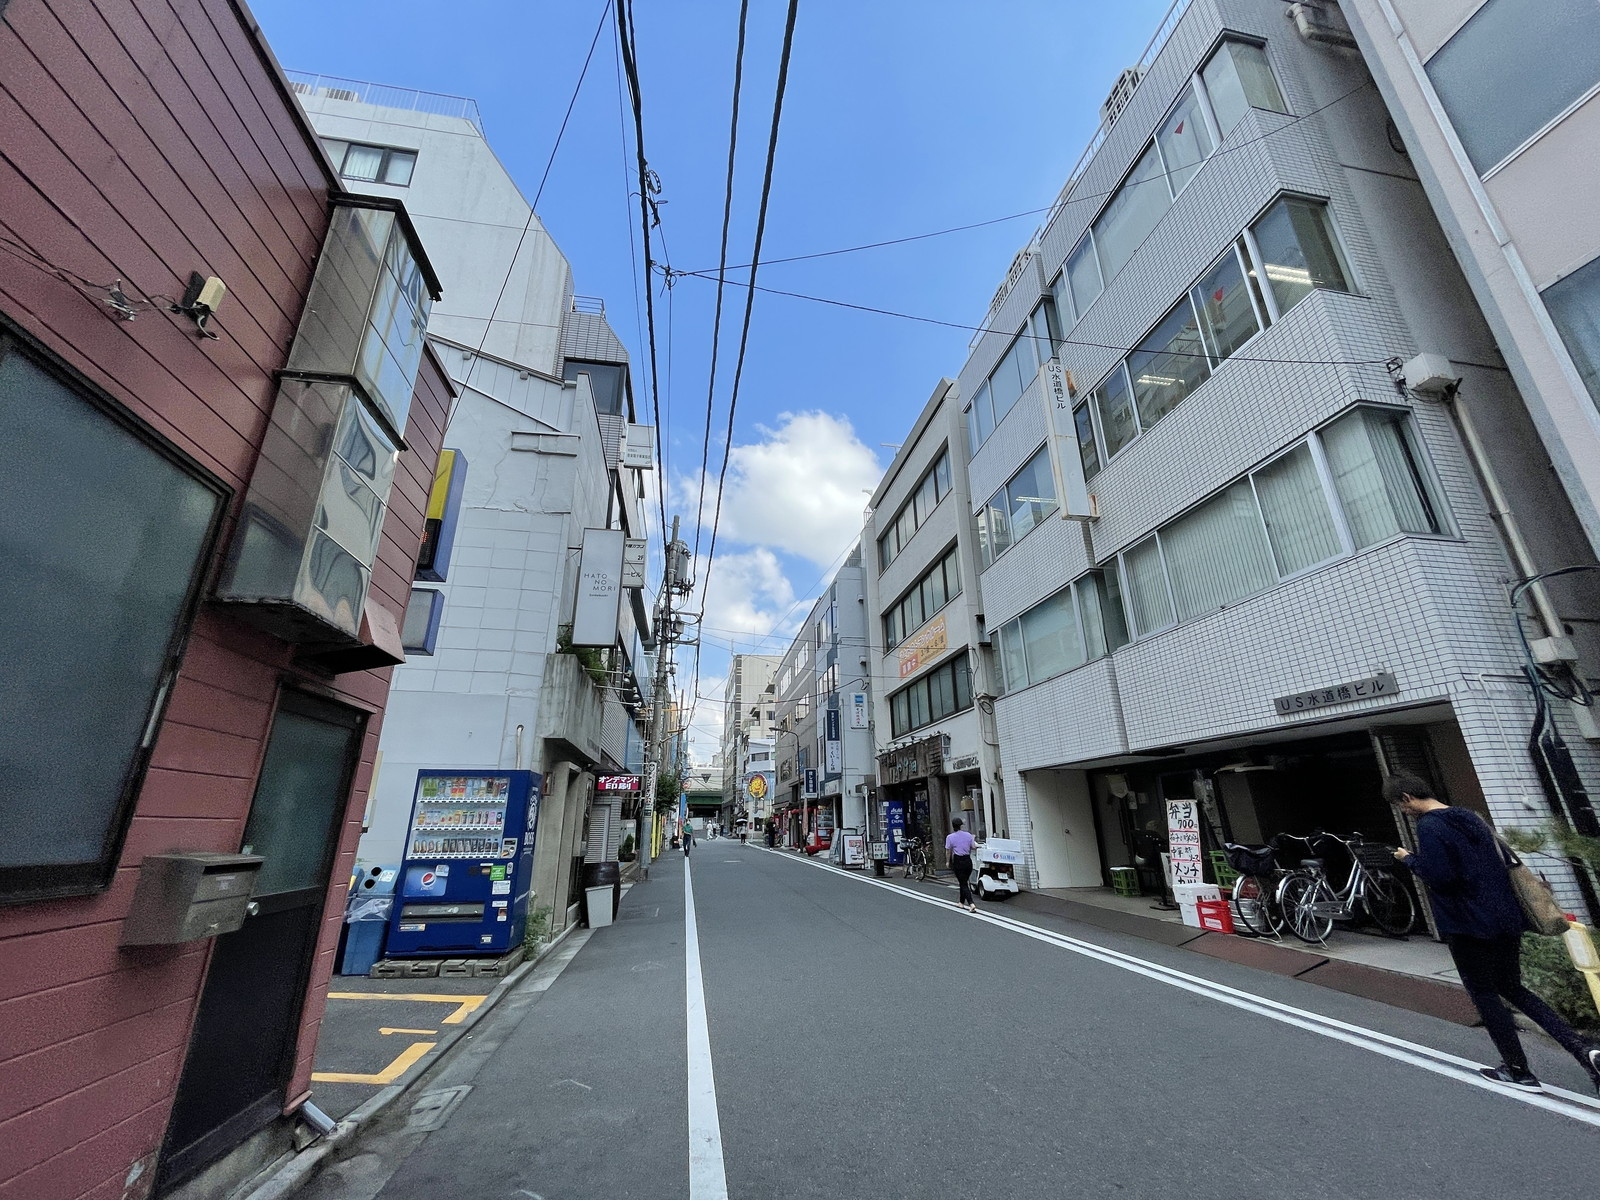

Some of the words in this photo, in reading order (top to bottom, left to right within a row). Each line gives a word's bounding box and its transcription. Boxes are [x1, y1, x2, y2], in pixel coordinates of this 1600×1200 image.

[1281, 680, 1385, 711] US水道橋ビル
[1169, 802, 1192, 819] 弁当
[1174, 862, 1200, 876] メンチ
